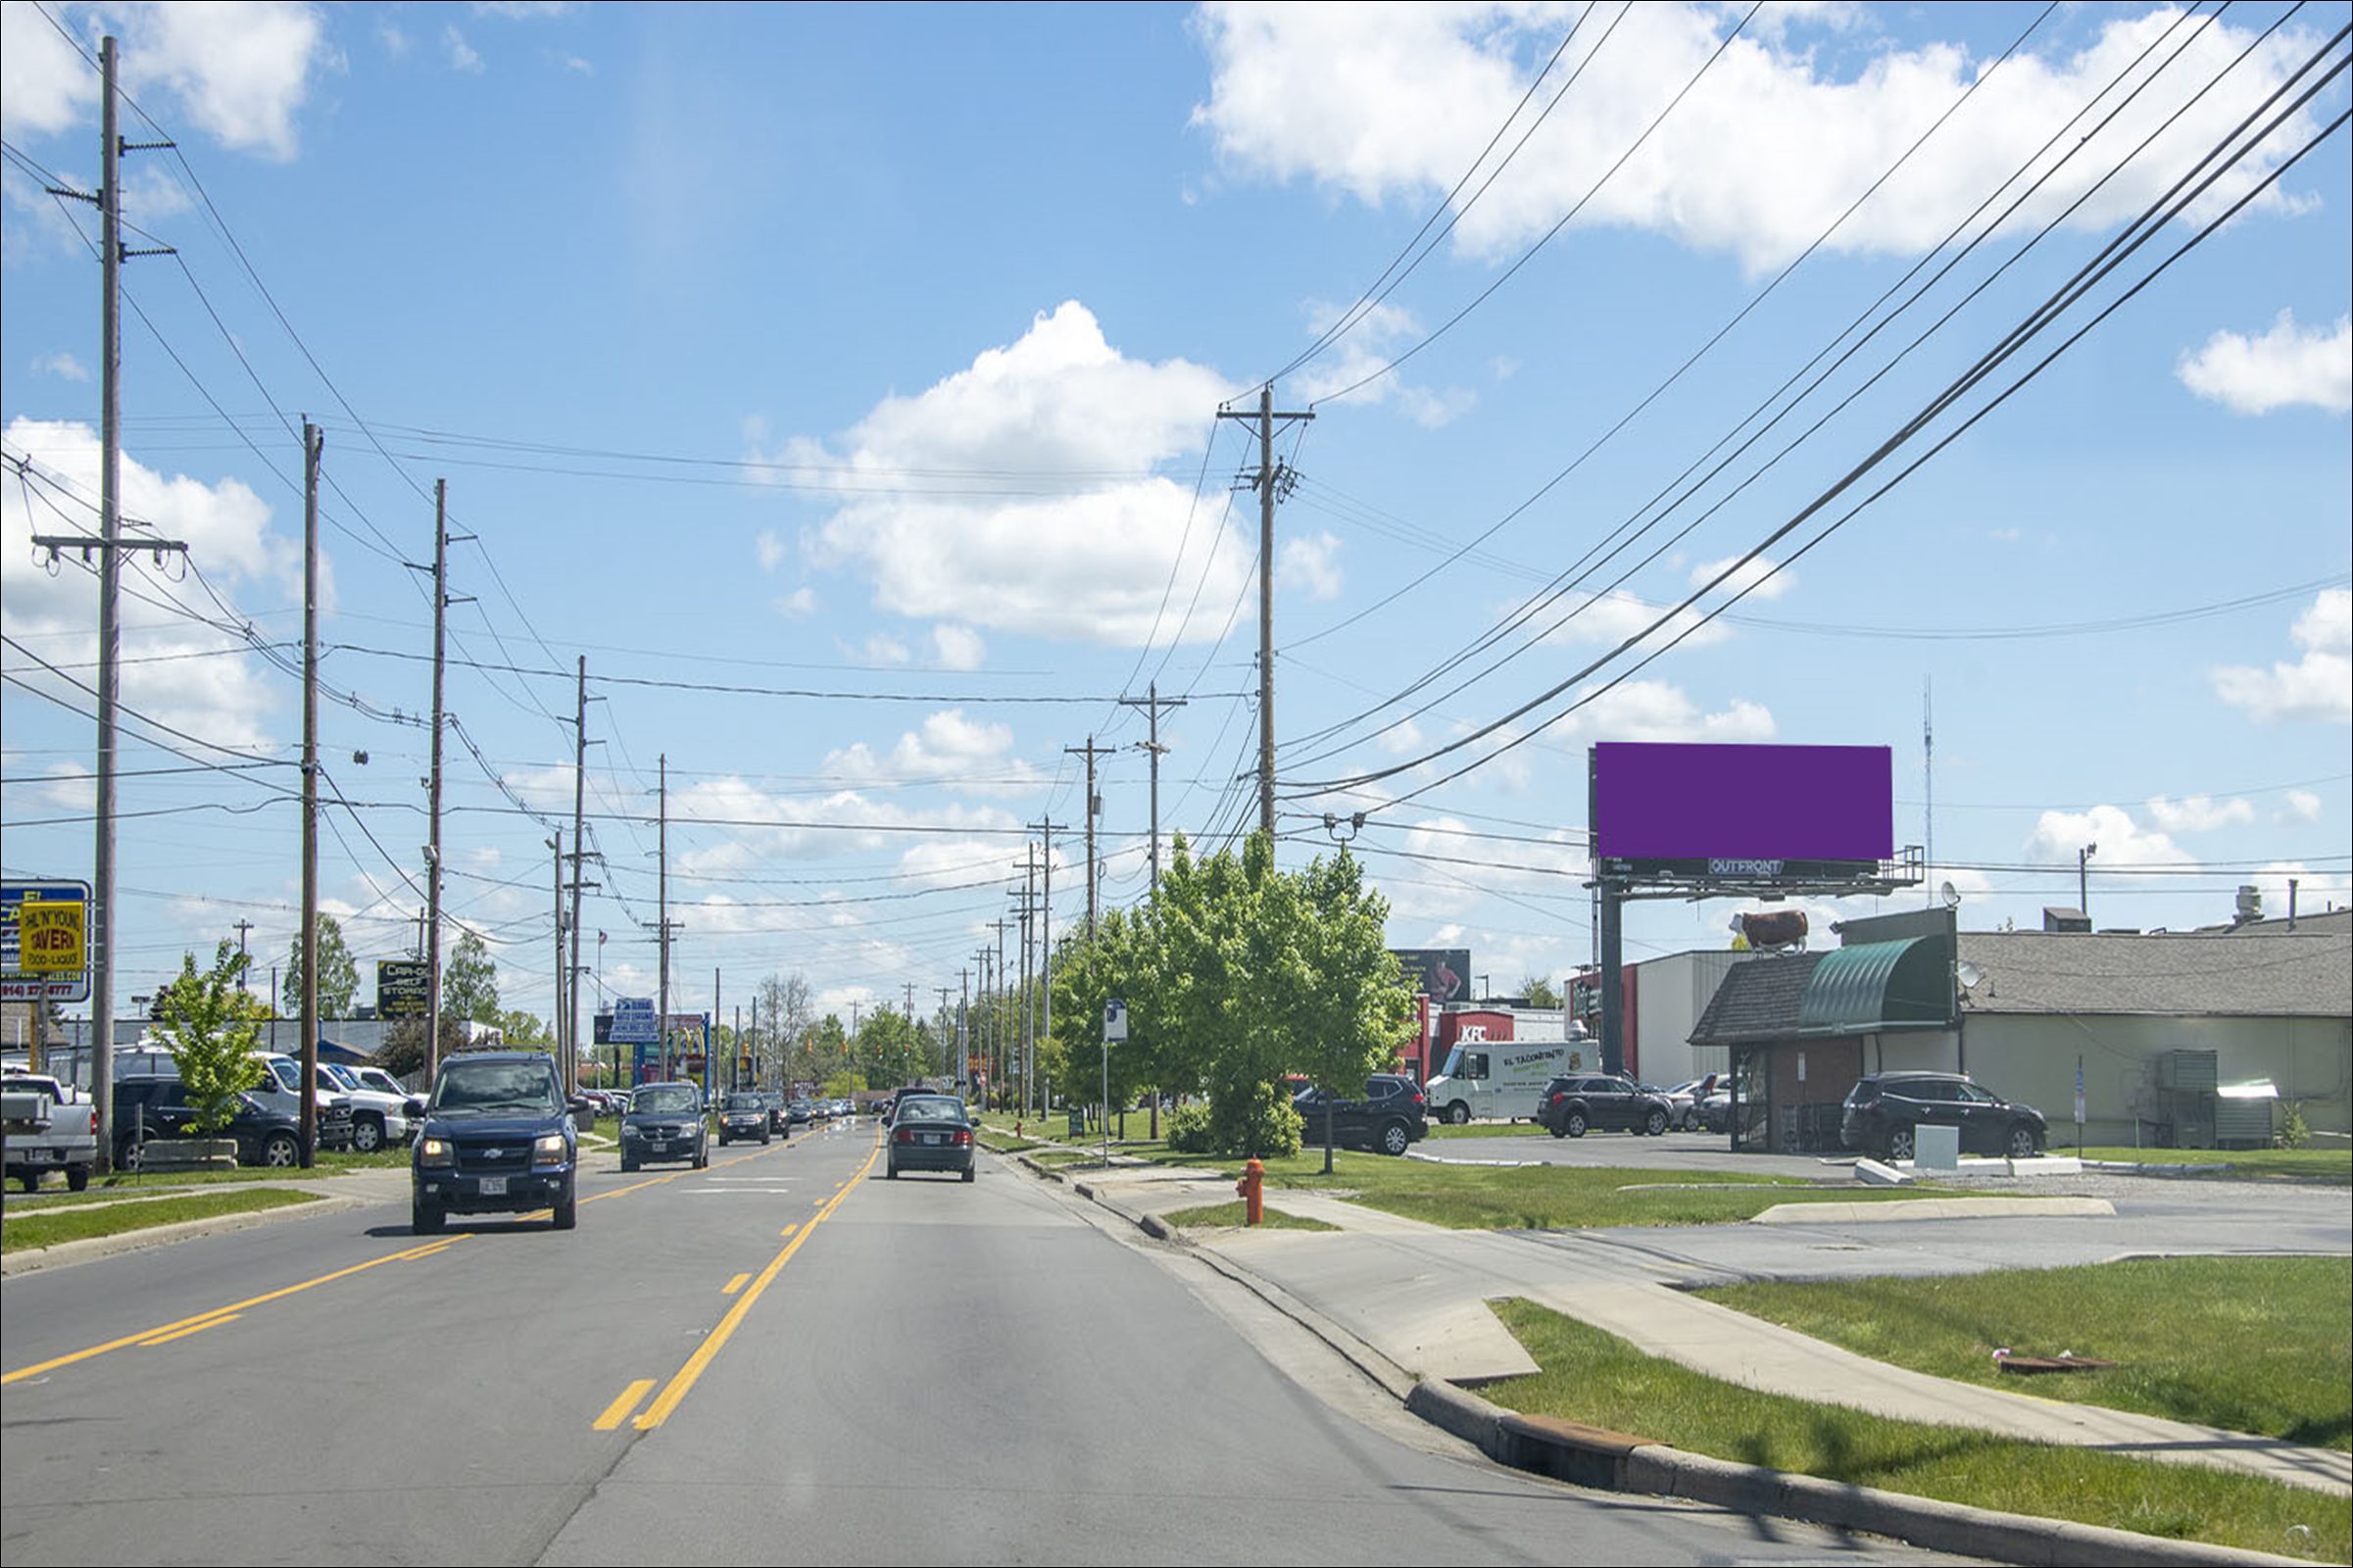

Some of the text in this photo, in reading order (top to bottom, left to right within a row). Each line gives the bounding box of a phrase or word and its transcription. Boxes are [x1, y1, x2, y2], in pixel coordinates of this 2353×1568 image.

[1711, 859, 1781, 872] OUTFRONT
[30, 928, 75, 951] TAVERN
[1460, 1025, 1488, 1042] KFC
